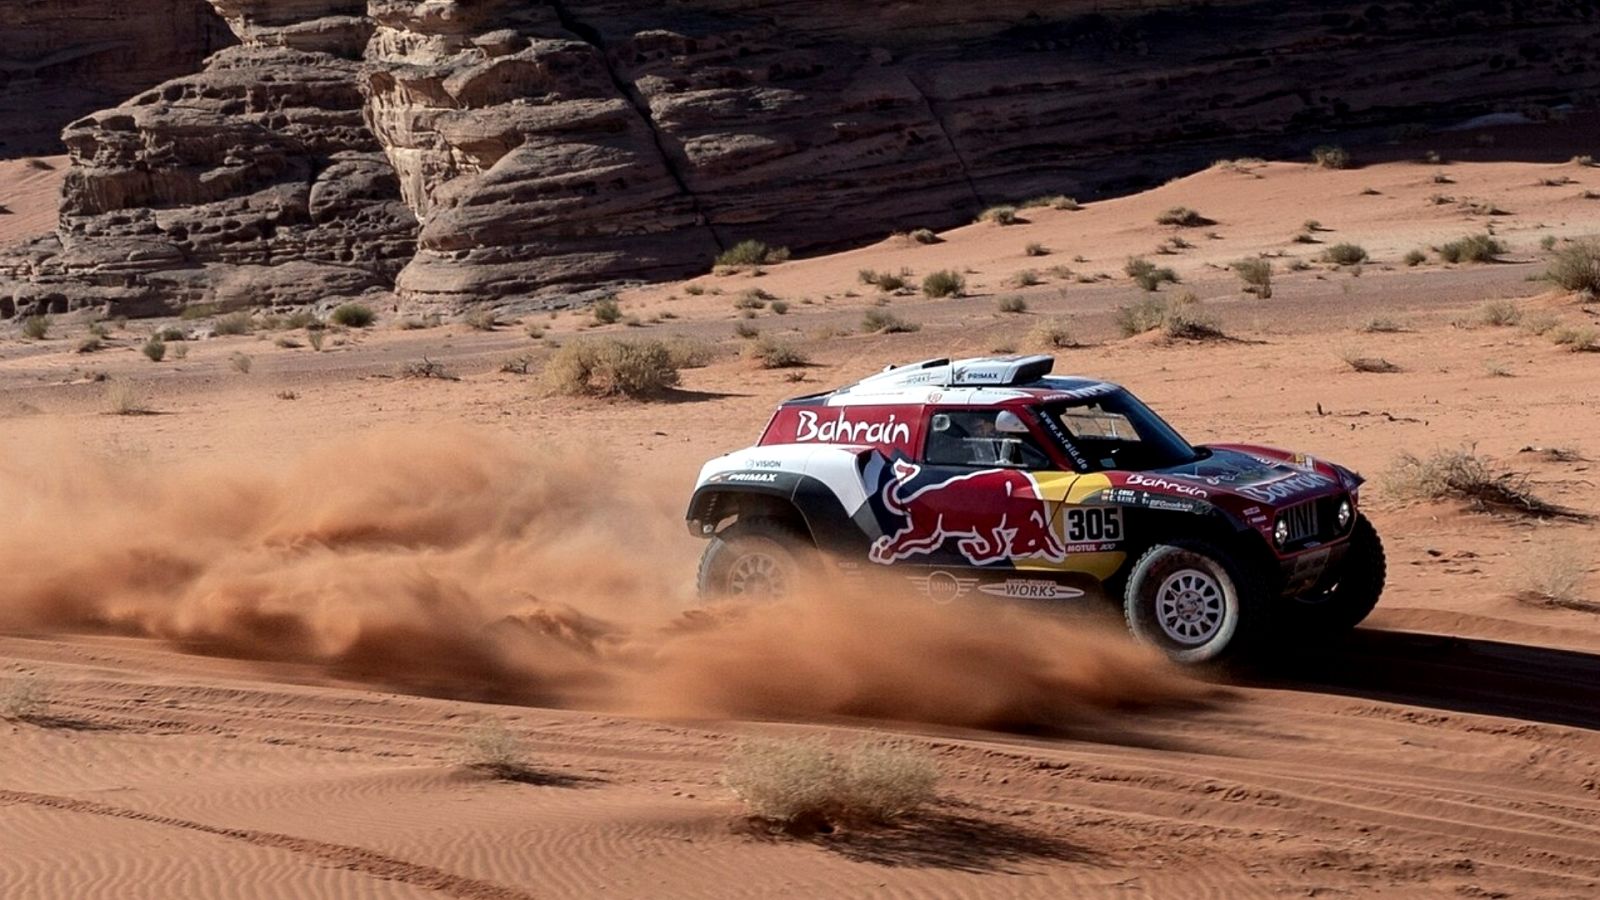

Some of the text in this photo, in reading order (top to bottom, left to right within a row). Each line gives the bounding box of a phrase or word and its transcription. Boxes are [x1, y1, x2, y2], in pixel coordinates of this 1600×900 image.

[967, 372, 999, 380] PRIMAX
[796, 410, 910, 444] Bahrain
[1040, 410, 1088, 470] www.x-raid.de
[755, 460, 782, 468] VISION
[727, 473, 778, 482] PRIMAX
[1126, 474, 1208, 498] Bahrain
[1068, 508, 1120, 541] 305
[1067, 544, 1097, 552] MOTUL
[1006, 584, 1056, 597] WORKS
